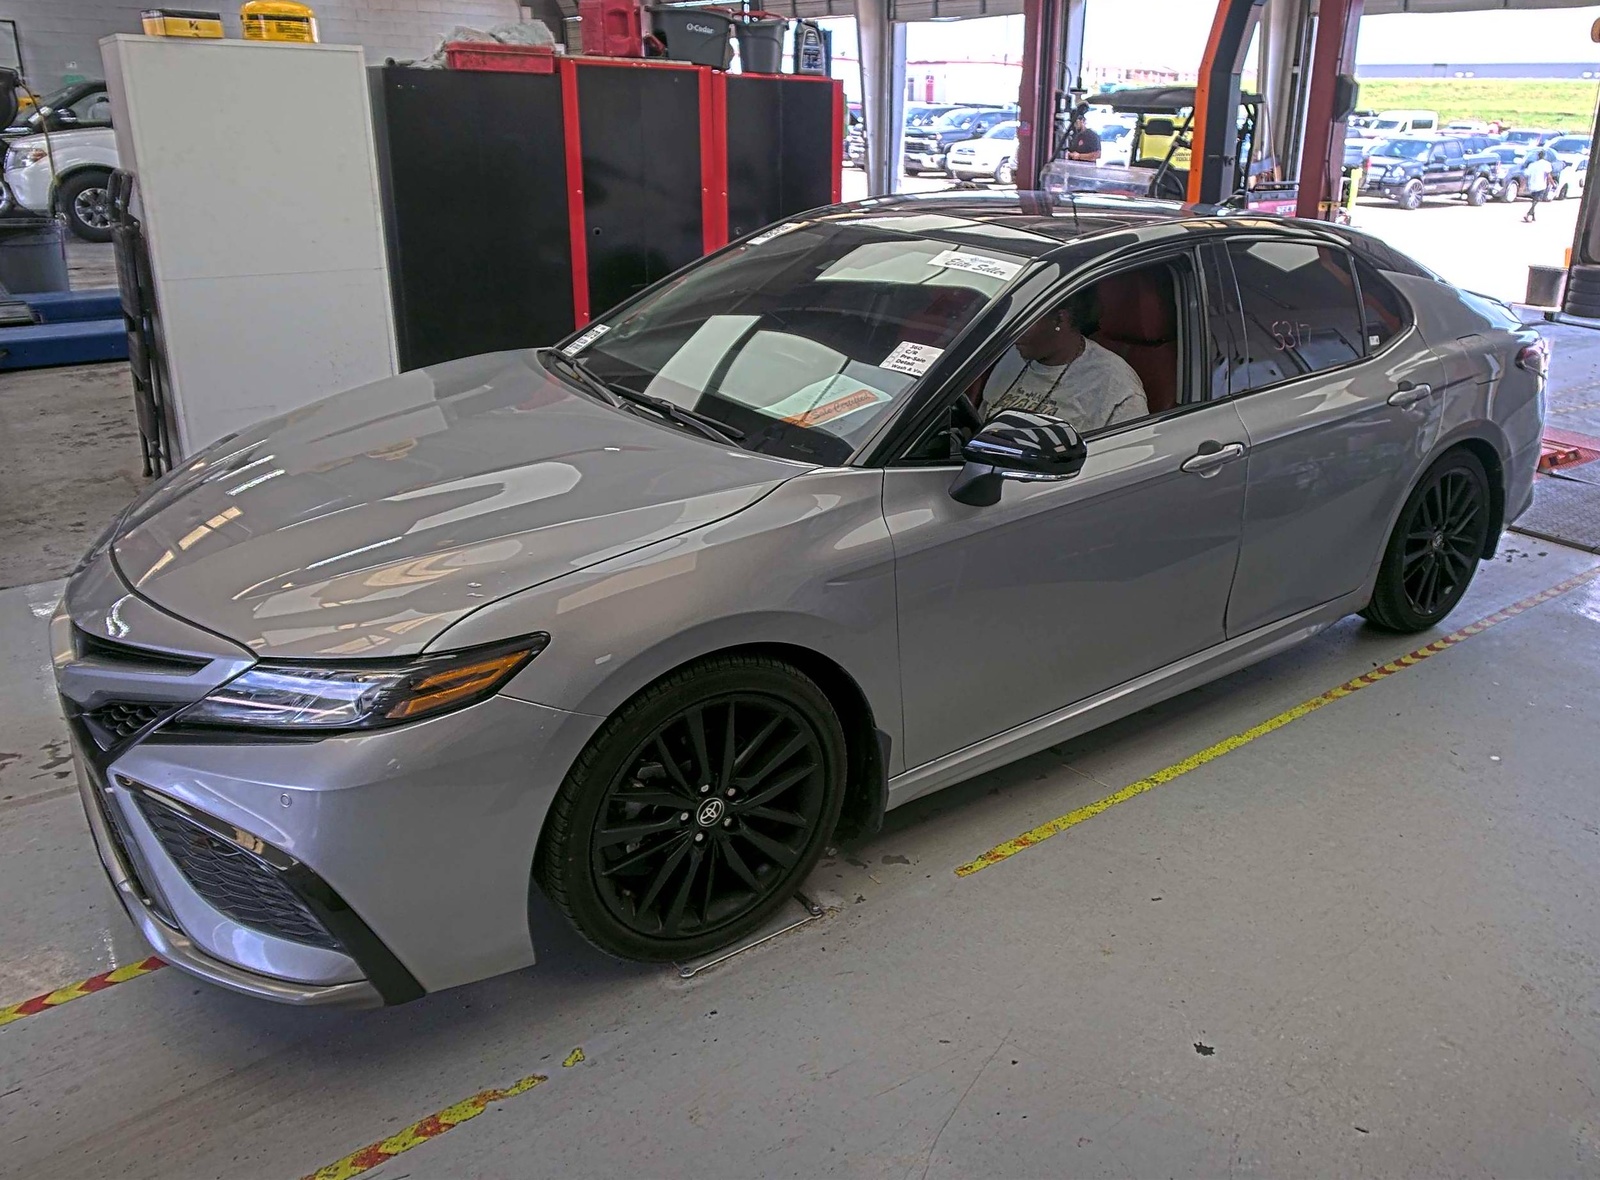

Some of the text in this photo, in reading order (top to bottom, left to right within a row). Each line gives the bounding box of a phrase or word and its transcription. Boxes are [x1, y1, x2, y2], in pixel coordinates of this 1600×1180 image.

[972, 264, 1006, 276] Seller
[1271, 320, 1312, 351] 5317
[891, 363, 907, 371] Wash
[895, 358, 915, 367] Detail
